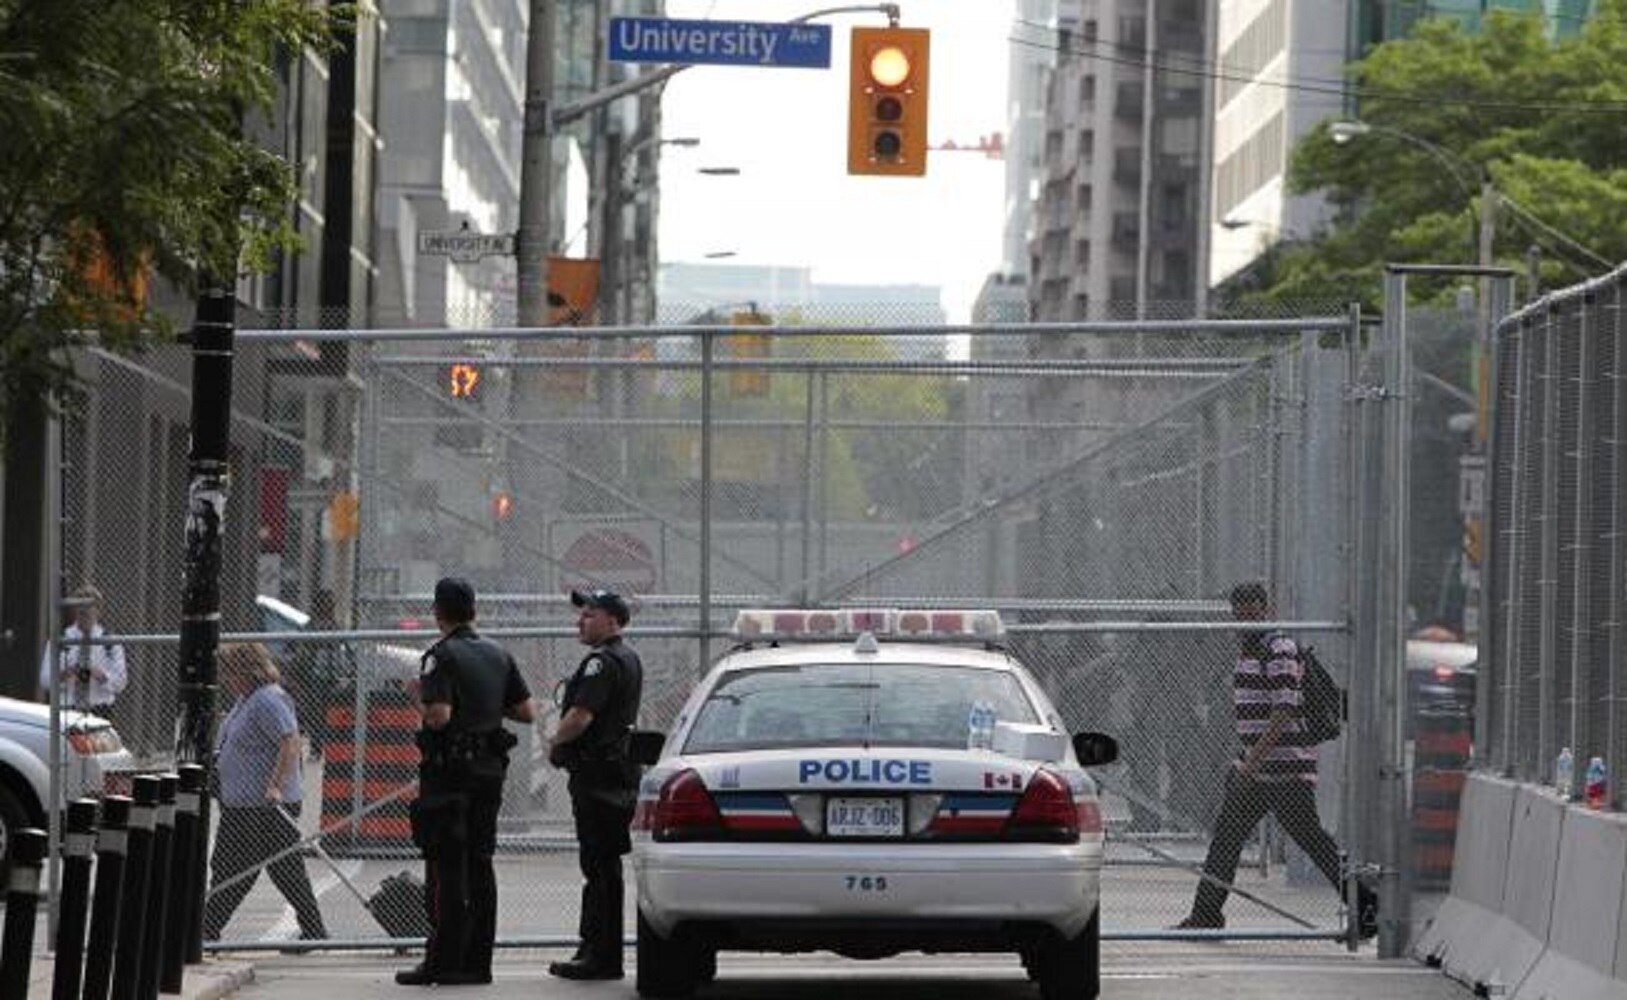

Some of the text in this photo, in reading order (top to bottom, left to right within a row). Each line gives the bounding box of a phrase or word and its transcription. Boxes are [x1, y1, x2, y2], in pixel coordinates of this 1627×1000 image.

[619, 21, 820, 63] University Ave
[799, 760, 932, 783] POLICE
